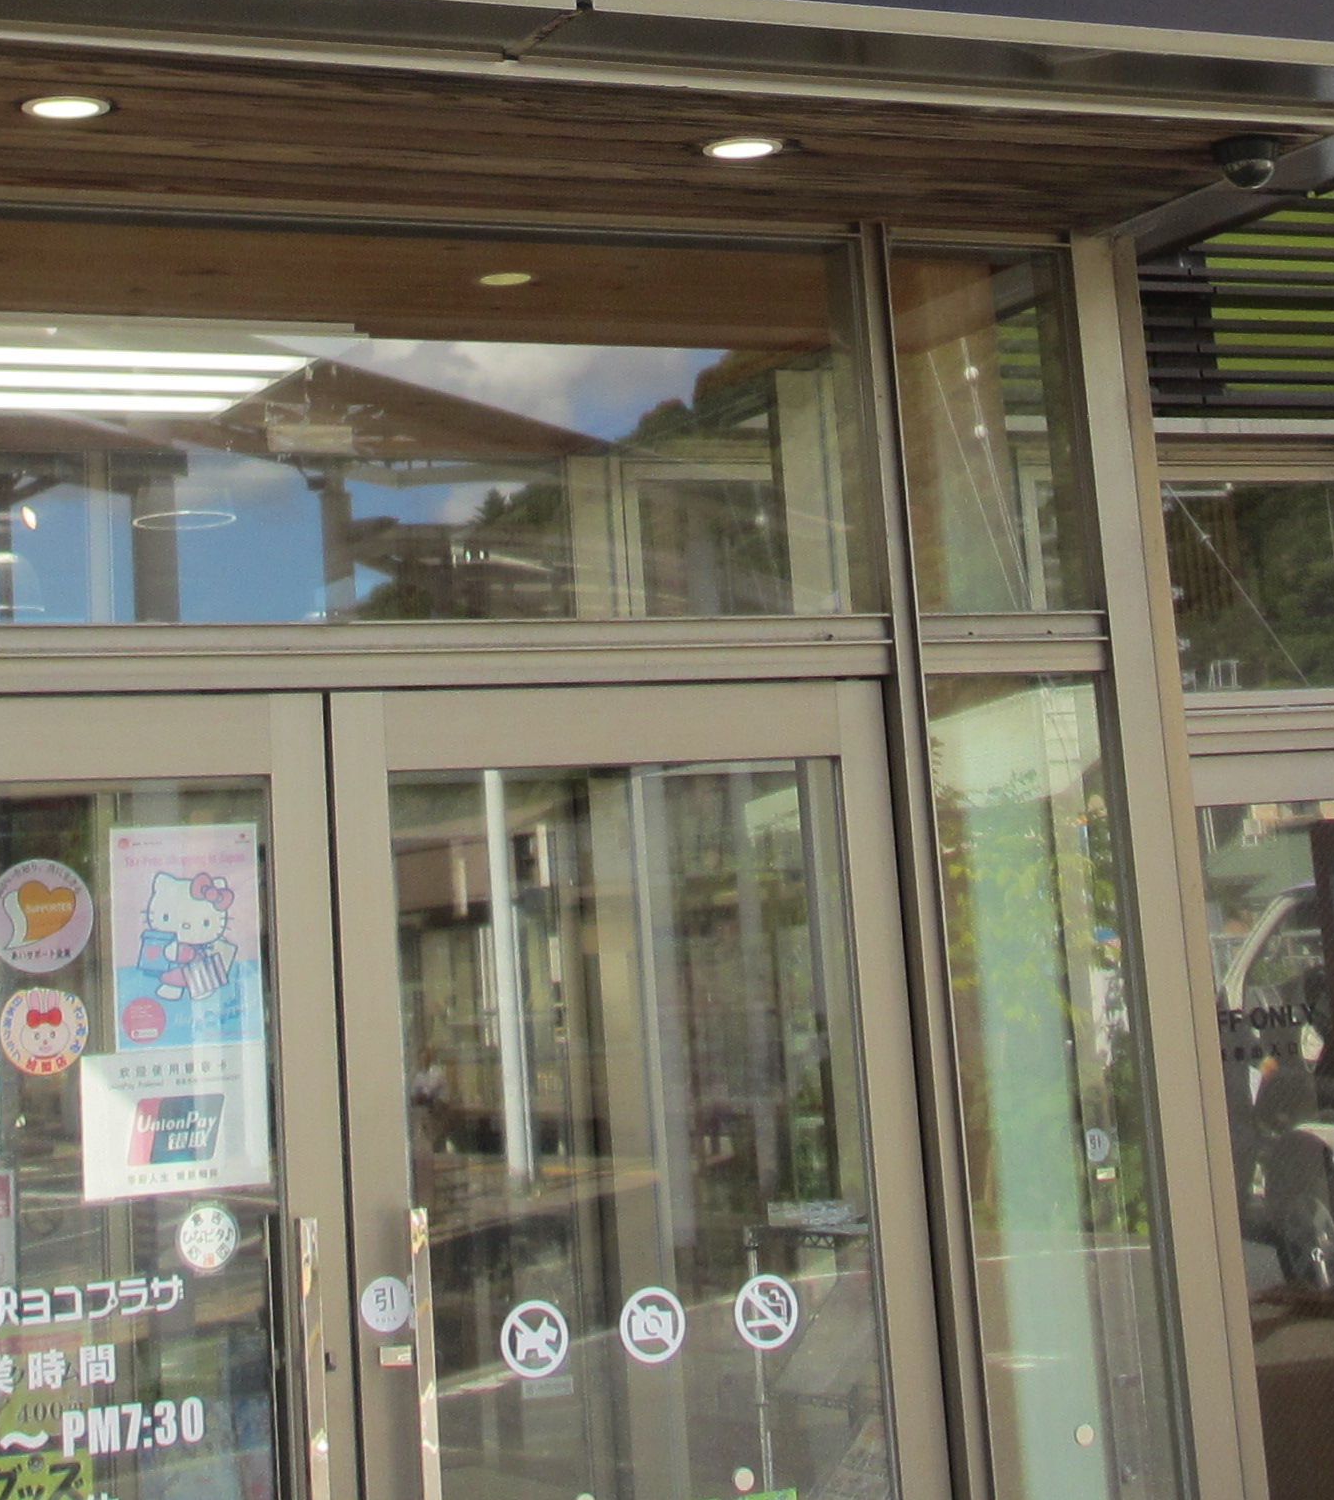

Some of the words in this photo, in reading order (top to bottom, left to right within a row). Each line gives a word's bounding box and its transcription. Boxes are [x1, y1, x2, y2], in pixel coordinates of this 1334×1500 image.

[1249, 1002, 1316, 1030] ONLY
[137, 1110, 217, 1133] UnionPay
[374, 1286, 396, 1312] 引
[62, 1397, 205, 1457] PM7:30
